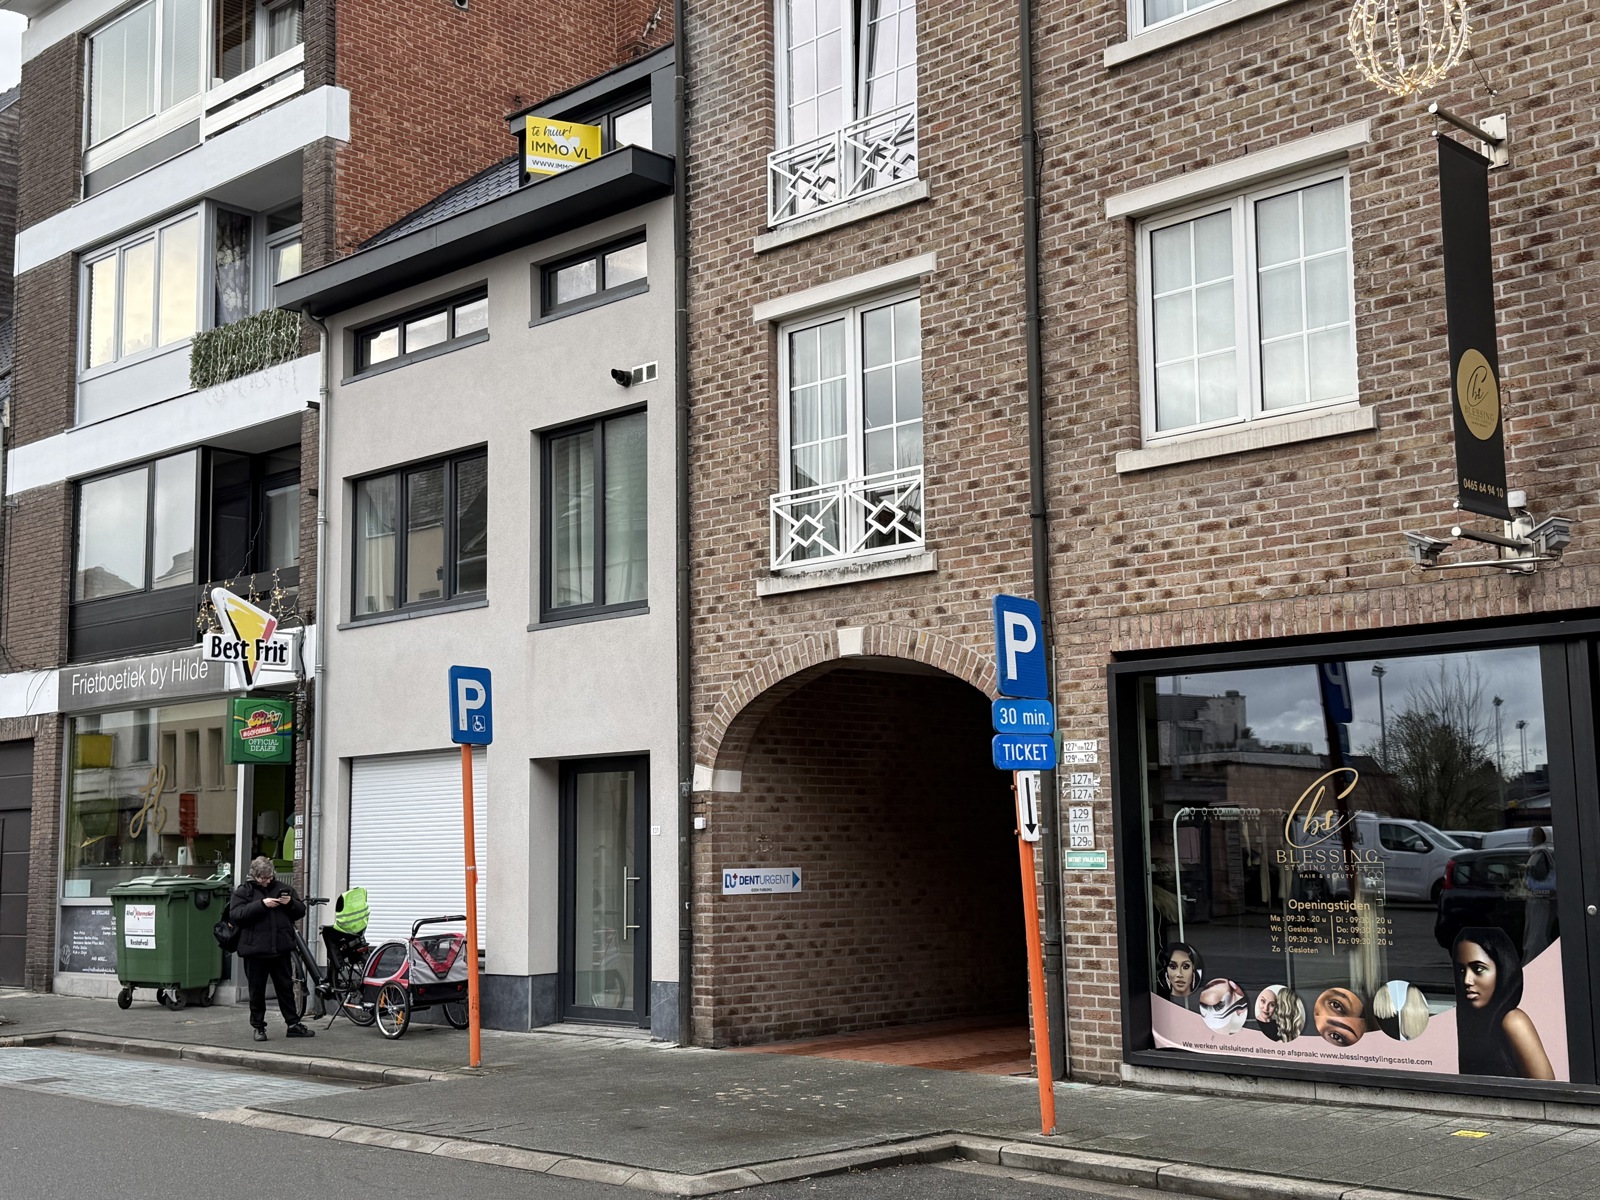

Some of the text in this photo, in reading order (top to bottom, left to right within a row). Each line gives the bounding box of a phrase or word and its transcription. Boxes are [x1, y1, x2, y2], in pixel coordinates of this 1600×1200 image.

[531, 125, 573, 137] te huur!
[531, 141, 592, 160] IMMO VL
[1464, 404, 1495, 421] BLESSING
[1463, 478, 1504, 498] 0465 64 94 10
[211, 635, 288, 663] Best Frit
[1003, 610, 1037, 680] P
[72, 657, 209, 696] Frietboetiek by Hilde
[457, 678, 486, 731] P
[1000, 707, 1050, 726] 30 min.
[1003, 743, 1048, 761] TICKET
[1072, 789, 1093, 800] 127A
[1072, 808, 1089, 819] 129
[1072, 823, 1090, 834] t/m
[1276, 849, 1379, 864] BLESSING
[739, 875, 790, 885] DENTURGENT
[1288, 898, 1371, 913] Openingstijden
[1286, 915, 1306, 923] 09:30
[1287, 925, 1318, 933] Gesloten
[1288, 946, 1319, 954] Gesloten
[1219, 1044, 1254, 1053] uitsluitend
[1255, 1047, 1276, 1055] alleen
[1319, 1052, 1433, 1066] www.blessingstylingcastle.com
